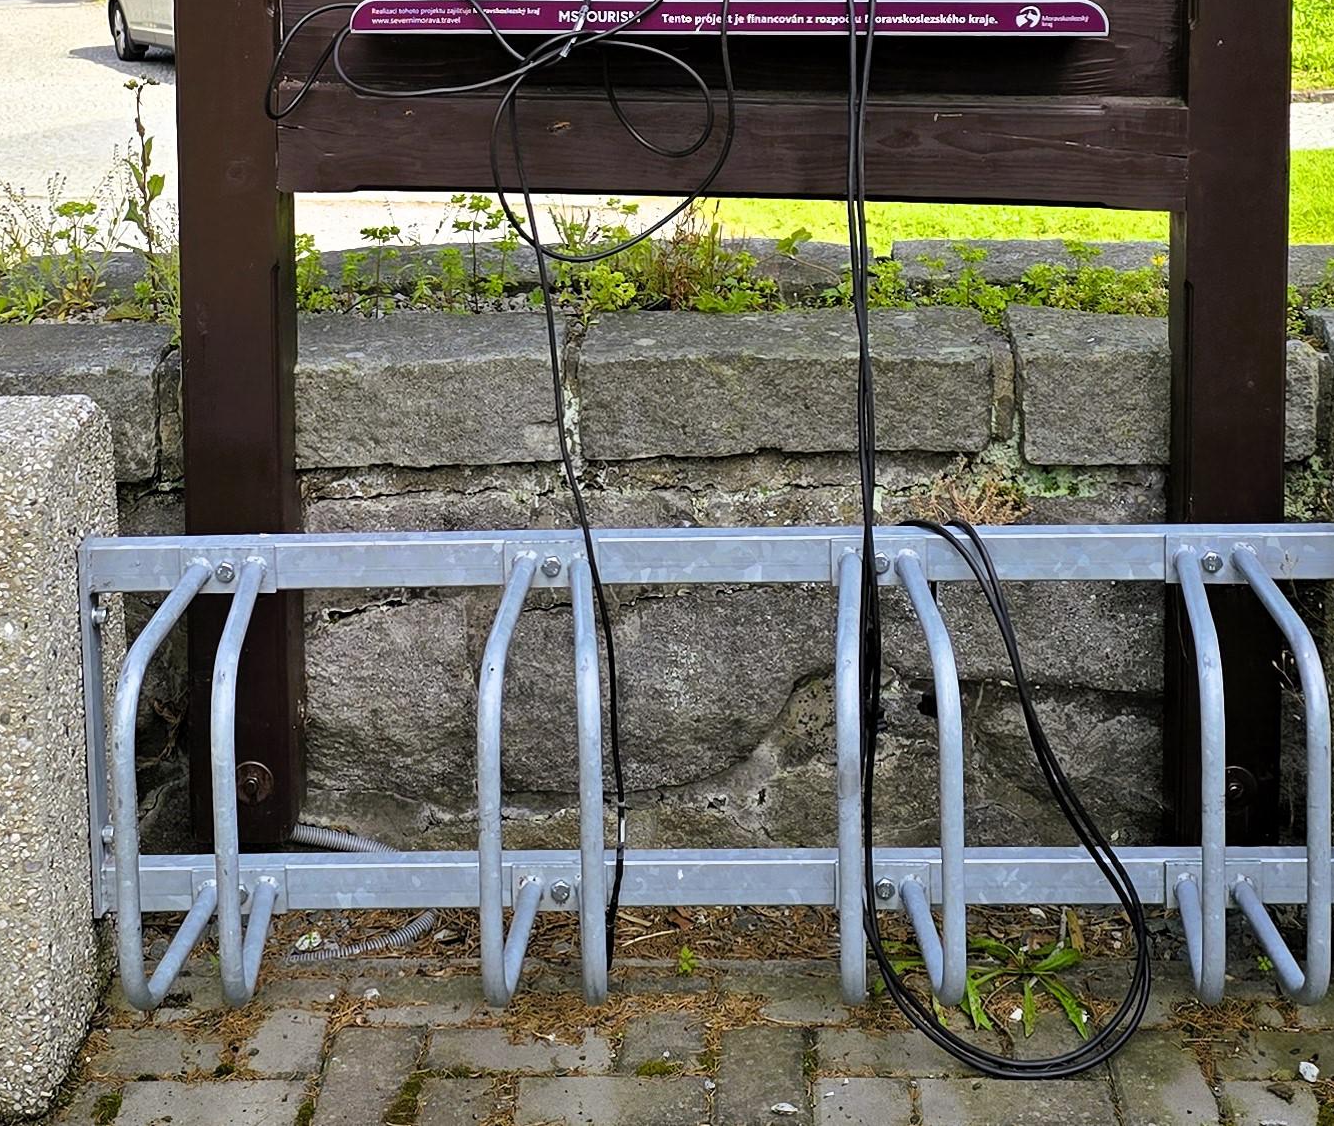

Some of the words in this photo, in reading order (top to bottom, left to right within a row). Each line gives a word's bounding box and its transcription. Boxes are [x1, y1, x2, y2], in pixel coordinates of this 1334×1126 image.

[558, 10, 641, 23] MSOURIS
[661, 13, 692, 24] Tento
[694, 14, 733, 25] projet
[734, 14, 745, 25] je
[747, 13, 804, 24] financován
[815, 14, 862, 26] rozpoču
[968, 13, 998, 27] kraje.
